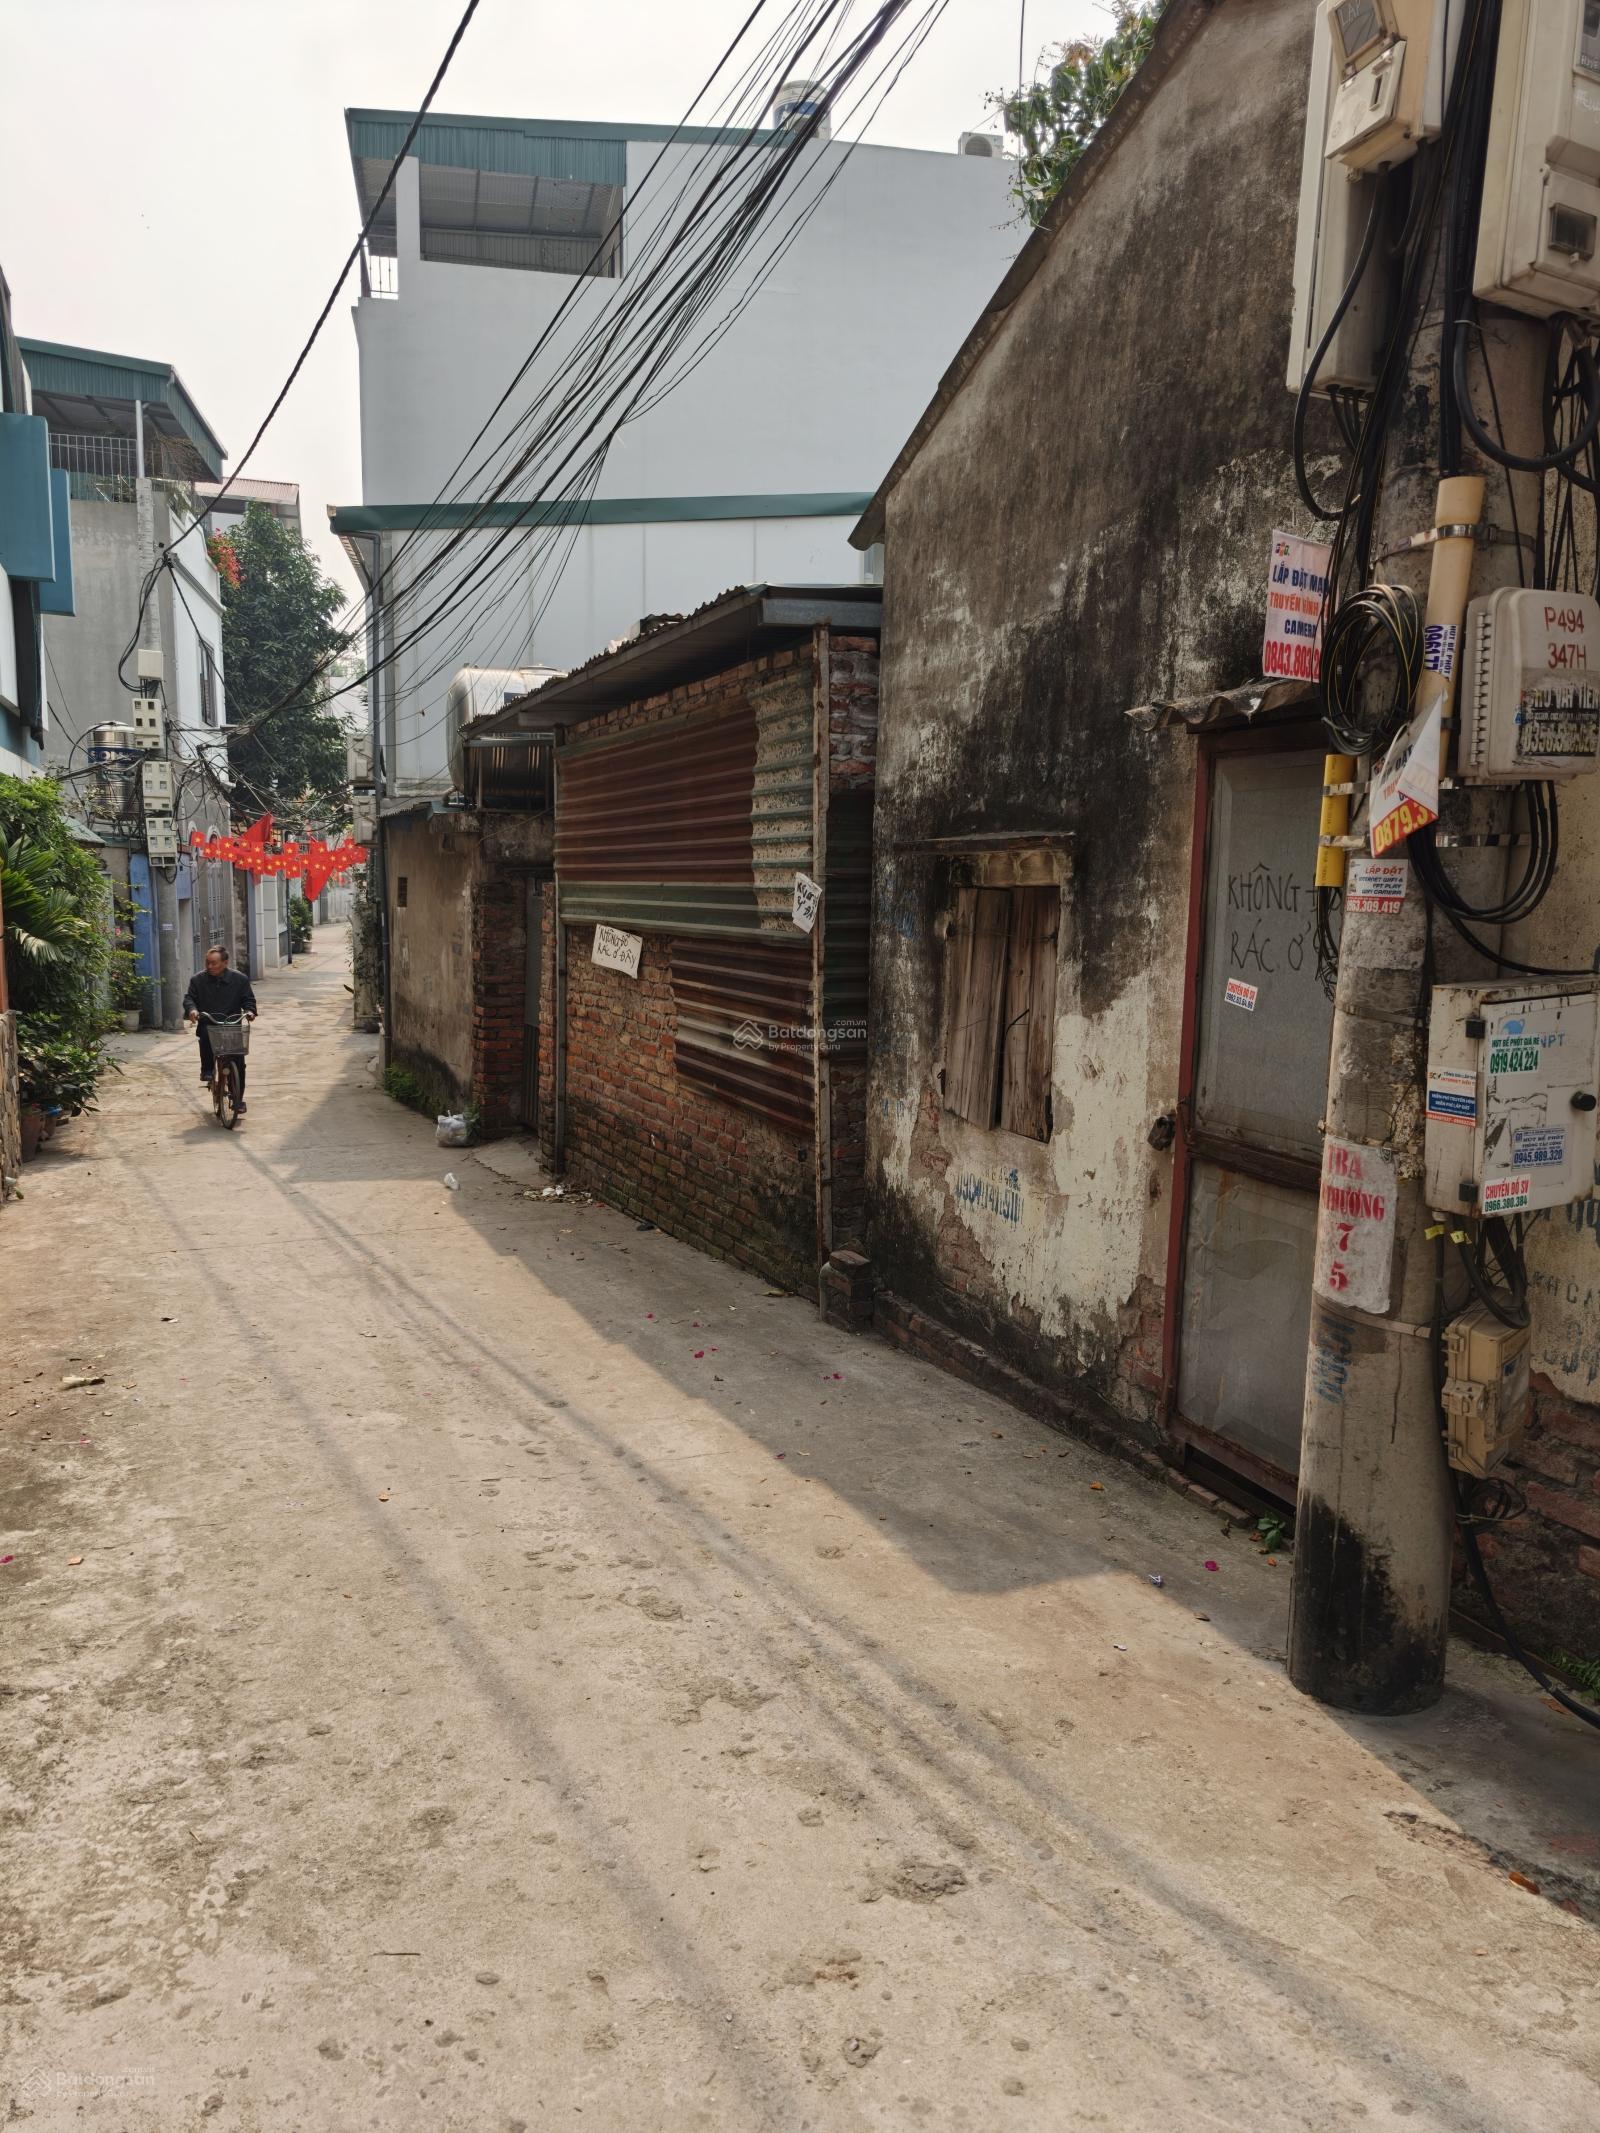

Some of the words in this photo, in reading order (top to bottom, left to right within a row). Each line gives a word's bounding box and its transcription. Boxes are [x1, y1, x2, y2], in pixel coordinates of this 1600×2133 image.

[1548, 643, 1587, 671] 347H
[1228, 862, 1300, 913] KHÔNG
[1336, 1222, 1354, 1252] 7
[1329, 1261, 1349, 1291] 5
